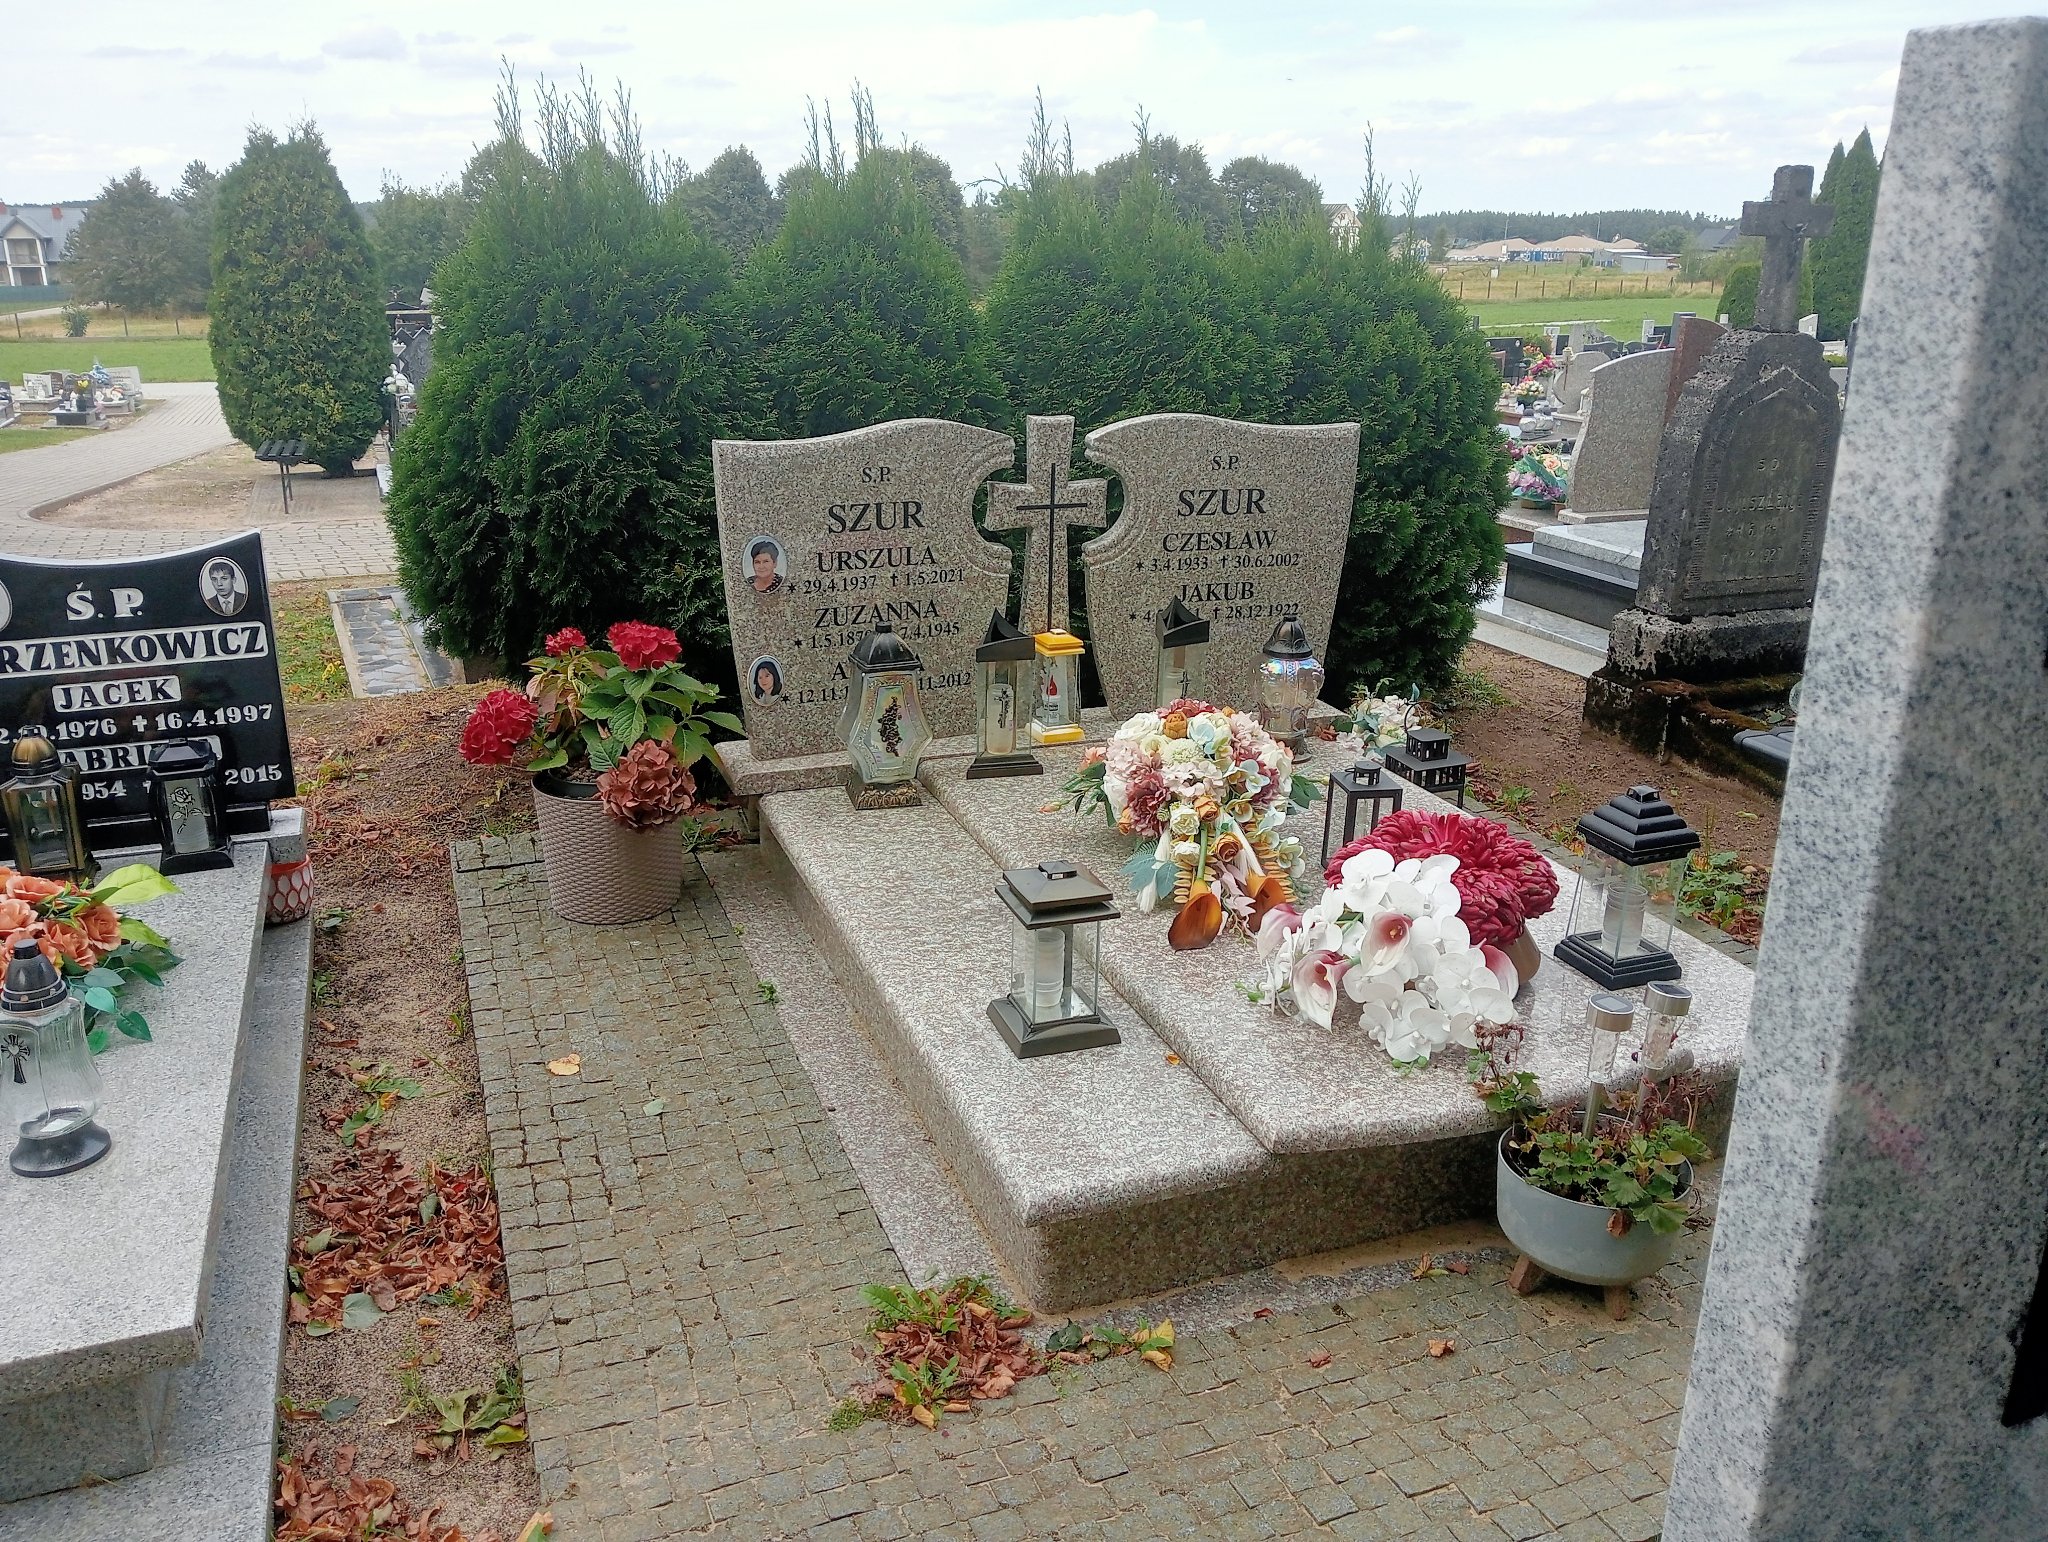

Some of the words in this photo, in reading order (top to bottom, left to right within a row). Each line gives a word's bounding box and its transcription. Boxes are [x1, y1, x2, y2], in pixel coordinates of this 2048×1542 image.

[1177, 488, 1267, 517] SZUR
[828, 500, 925, 534] SZUR
[1162, 529, 1278, 554] CZESŁAW
[816, 545, 938, 573] URSZULA
[1150, 556, 1209, 572] 3.4.1933
[1234, 553, 1300, 570] 30.6.2002
[803, 575, 877, 595] 29.4.1937
[906, 568, 965, 587] 1.5.2021
[1178, 582, 1255, 603] JAKUB
[814, 599, 940, 628] ZUZANNA
[1226, 603, 1300, 620] 28.12.1922
[59, 678, 174, 711] JACEK
[155, 703, 274, 732] 16.4.1997
